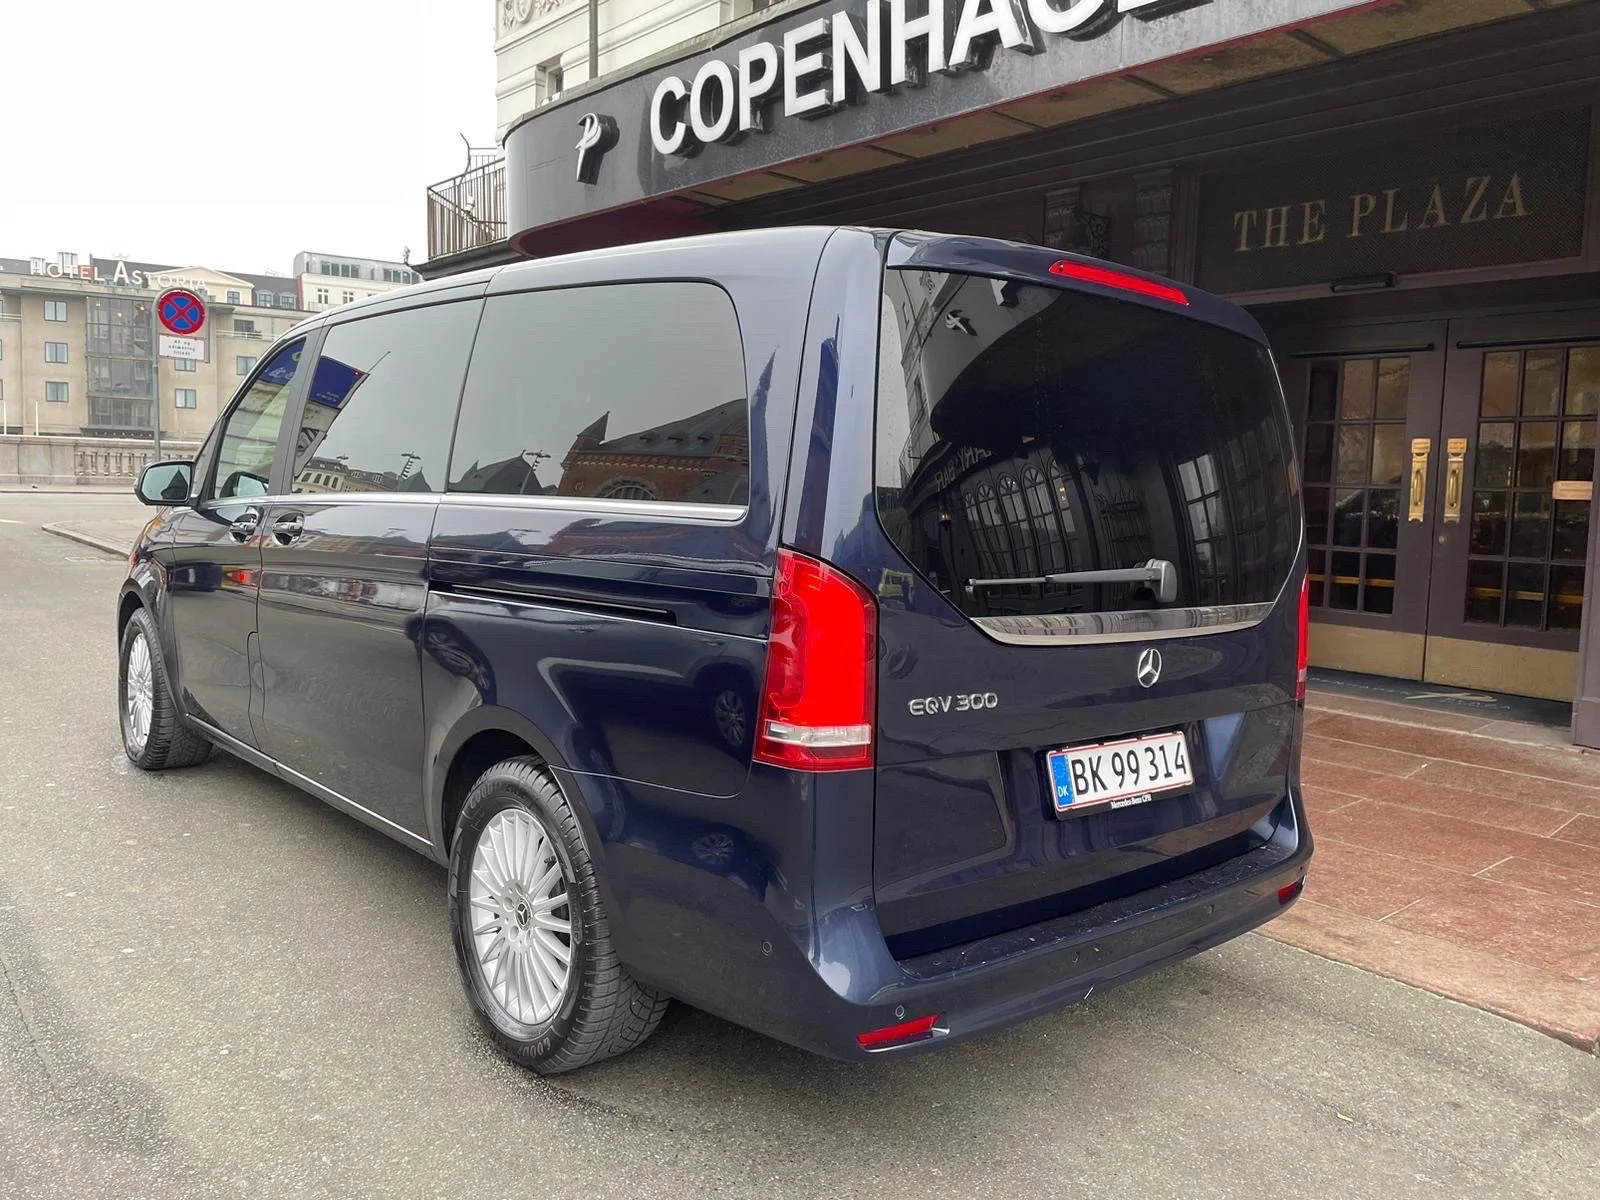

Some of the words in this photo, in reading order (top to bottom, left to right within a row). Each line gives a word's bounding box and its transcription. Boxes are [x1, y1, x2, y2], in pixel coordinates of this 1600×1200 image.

[650, 0, 1158, 156] COPENHA
[1233, 199, 1326, 252] THE
[1346, 171, 1529, 238] PLAZA
[29, 257, 105, 282] HOTEL
[907, 696, 952, 716] EQV
[955, 692, 998, 711] 300
[1071, 755, 1108, 796] BK
[1111, 750, 1140, 789] 99
[1144, 741, 1187, 782] 314
[1057, 786, 1069, 798] DK
